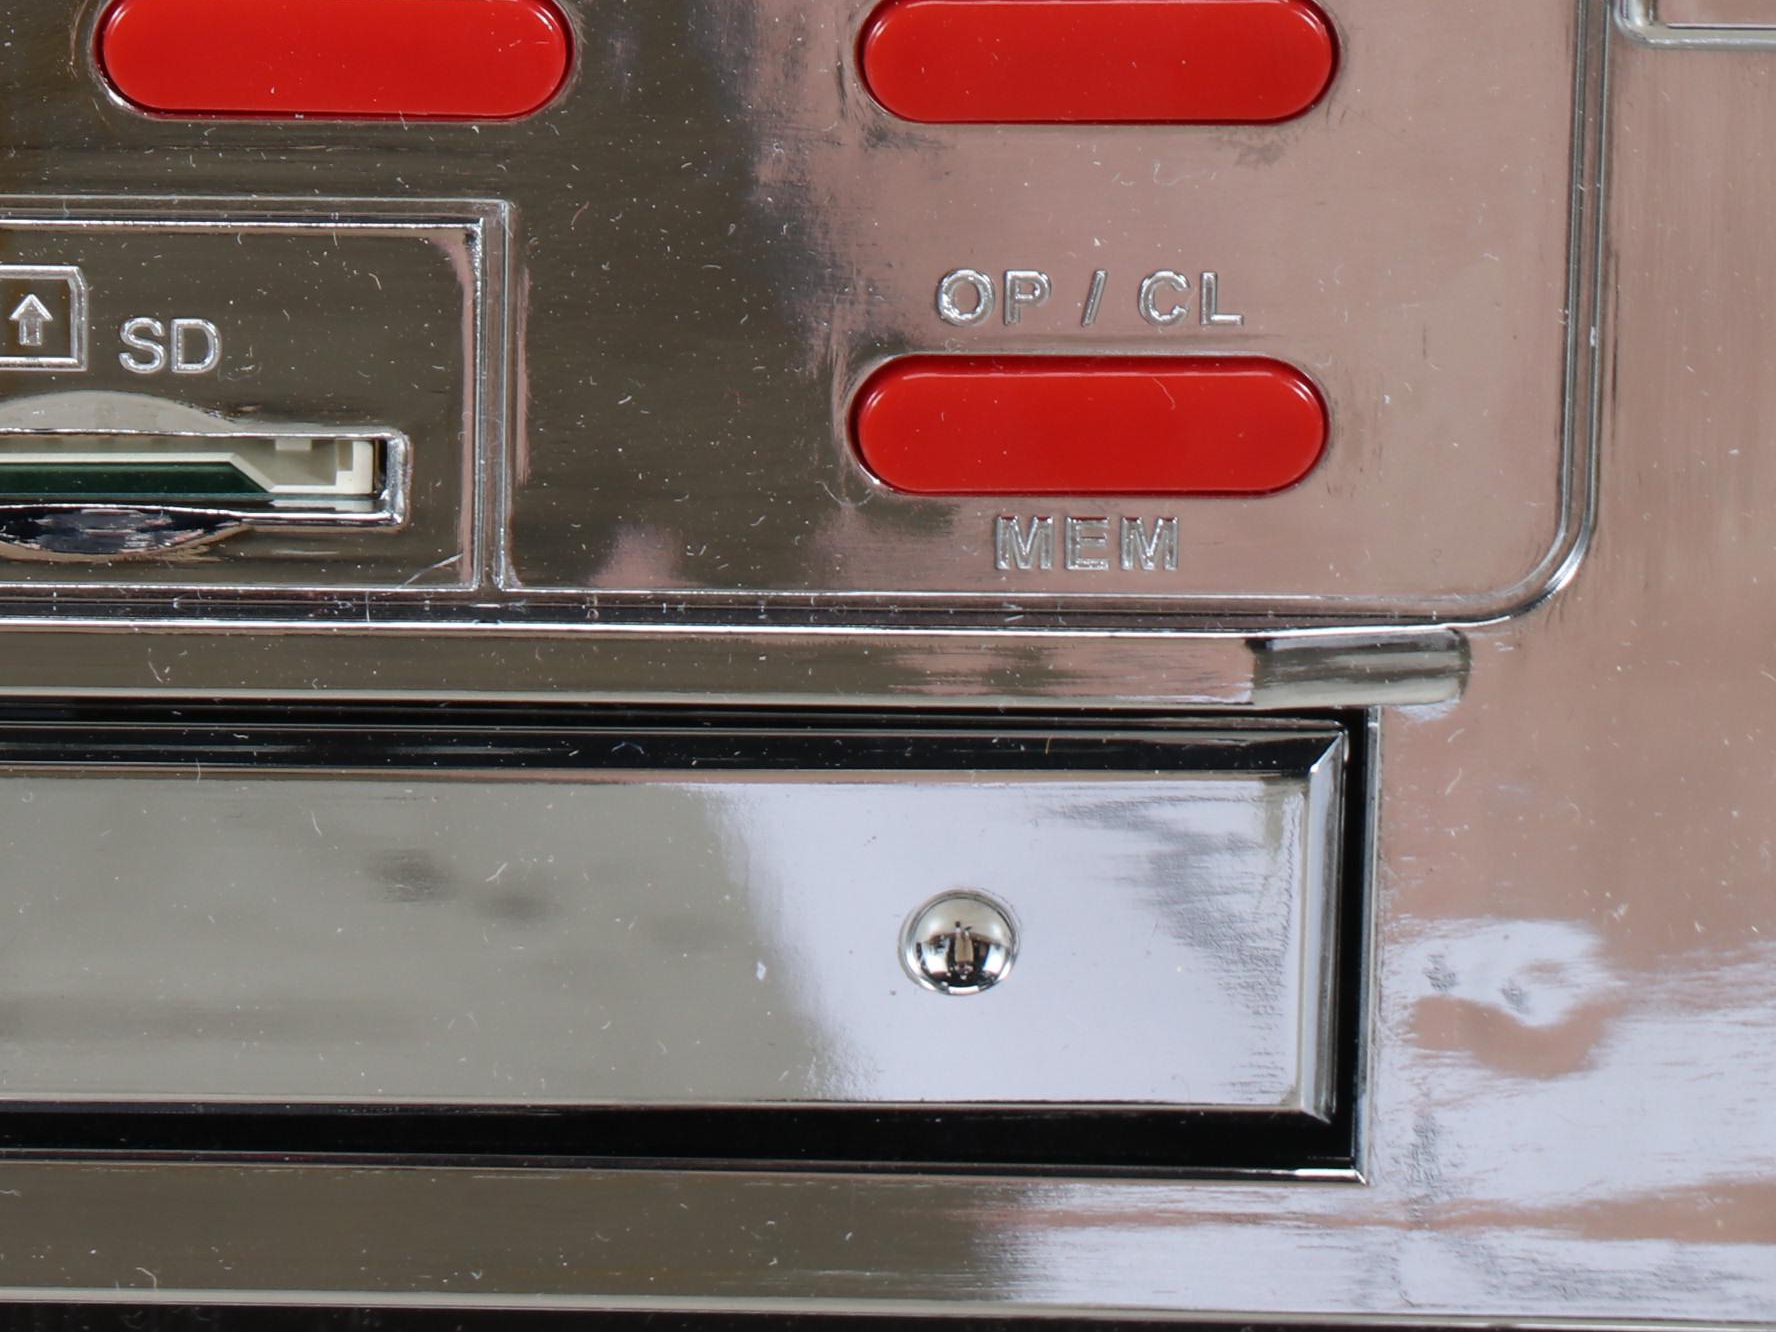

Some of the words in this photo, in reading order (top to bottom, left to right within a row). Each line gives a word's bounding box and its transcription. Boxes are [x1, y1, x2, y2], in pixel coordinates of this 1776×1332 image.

[936, 268, 1053, 327] OP
[1081, 269, 1109, 327] /
[1137, 270, 1244, 327] CL
[118, 317, 222, 374] SD
[994, 515, 1181, 570] MEM
